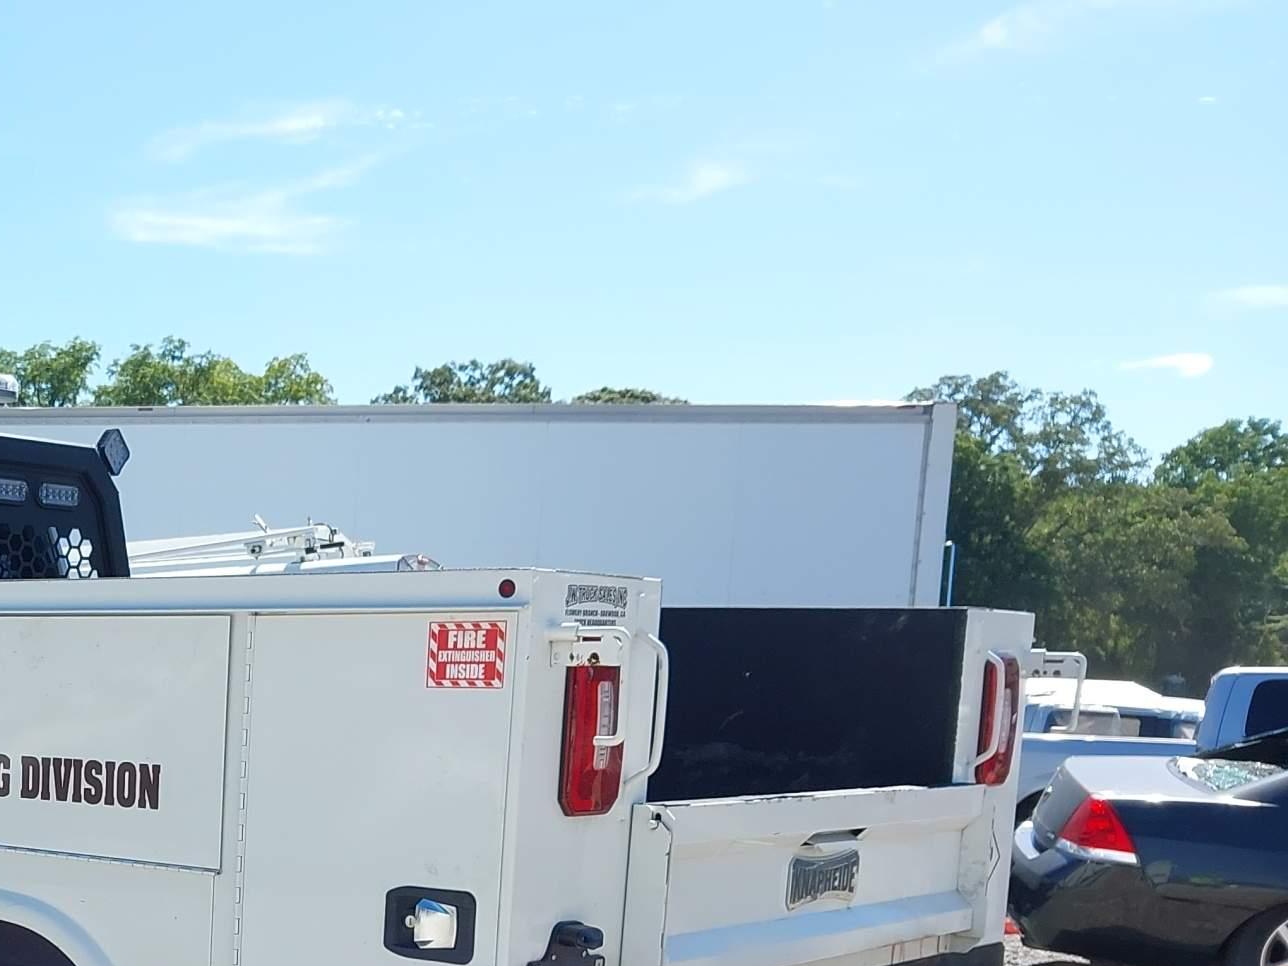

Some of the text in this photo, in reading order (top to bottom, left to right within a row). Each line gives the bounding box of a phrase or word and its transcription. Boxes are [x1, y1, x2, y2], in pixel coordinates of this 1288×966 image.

[447, 630, 487, 649] FIRE
[438, 650, 496, 662] EXTINGUISHER
[445, 663, 486, 679] INSIDE
[20, 755, 161, 810] DIVISION
[790, 863, 858, 905] KNAPHEIDE
